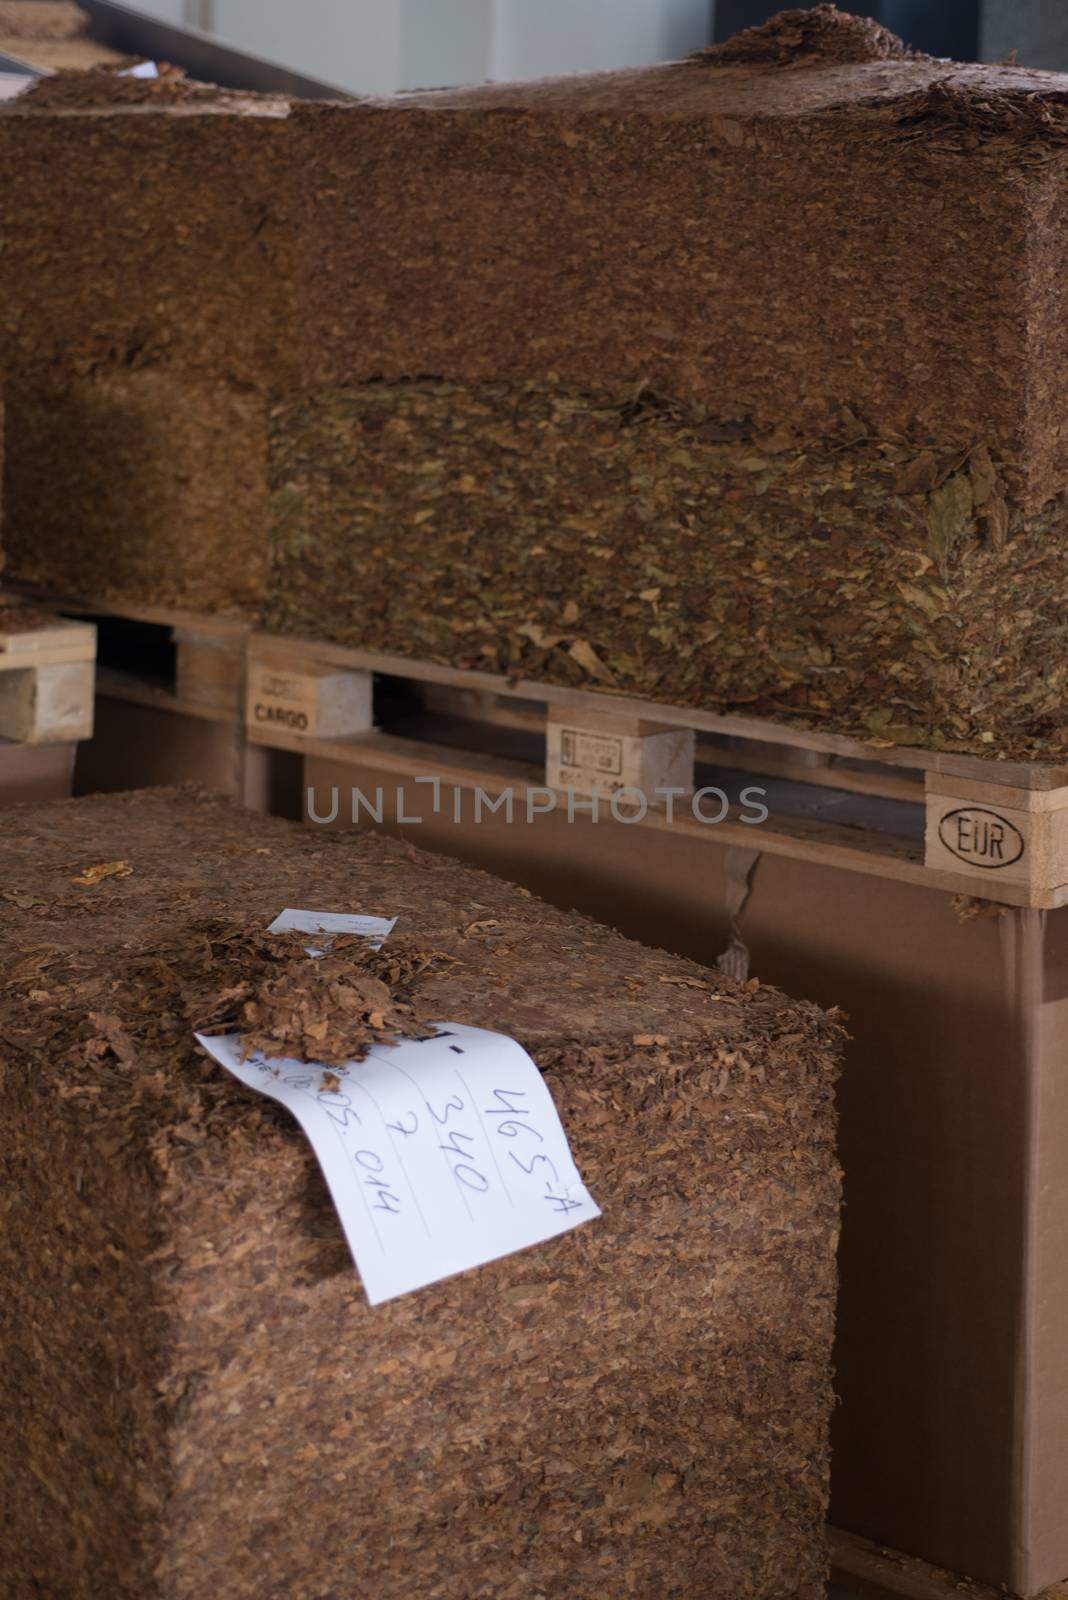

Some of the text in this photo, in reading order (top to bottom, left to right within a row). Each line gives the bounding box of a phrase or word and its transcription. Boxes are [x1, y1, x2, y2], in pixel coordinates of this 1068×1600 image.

[254, 702, 308, 731] CARGO
[957, 816, 1004, 860] EUR
[426, 1095, 489, 1193] 340
